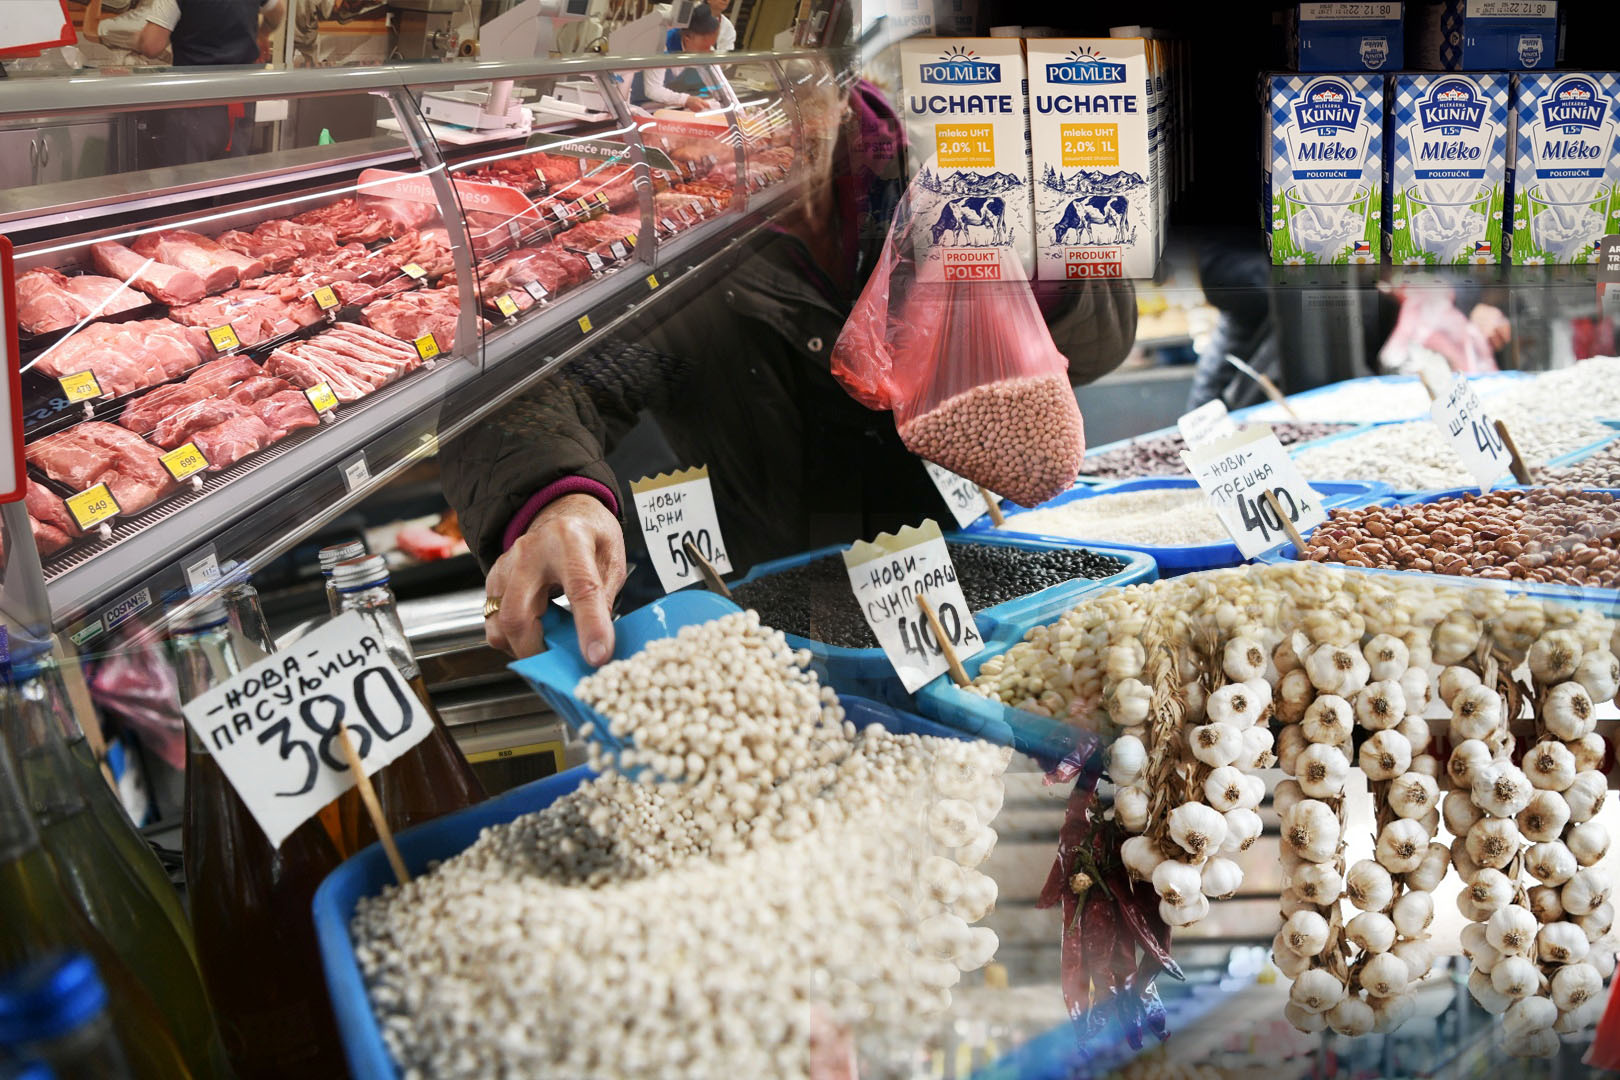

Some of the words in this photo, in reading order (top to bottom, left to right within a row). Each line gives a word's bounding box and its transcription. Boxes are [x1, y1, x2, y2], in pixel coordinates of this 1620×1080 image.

[923, 66, 997, 81] POLMLEK
[1049, 66, 1122, 81] POLMLEK
[911, 95, 1013, 114] UCHATE
[1036, 95, 1137, 114] UCHATE
[938, 128, 968, 138] mleko
[970, 129, 990, 137] UHT
[1064, 128, 1093, 137] mleko
[1095, 128, 1115, 136] UHT
[600, 147, 631, 158] meso
[940, 142, 971, 154] 2,0%
[977, 142, 991, 153] 1L
[1064, 142, 1096, 154] 2,0%
[1101, 141, 1116, 152] 1L
[1298, 142, 1358, 162] Mléko
[1420, 141, 1482, 161] Mléko
[1542, 140, 1602, 160] Mléko
[946, 252, 995, 262] PRODUKT
[1069, 250, 1117, 260] PRODUKT
[946, 266, 998, 279] POLSKI
[1068, 264, 1120, 278] POLSKI
[180, 455, 197, 468] 699
[88, 500, 108, 514] 849
[106, 595, 139, 622] COSTAN
[257, 666, 414, 798] 380
